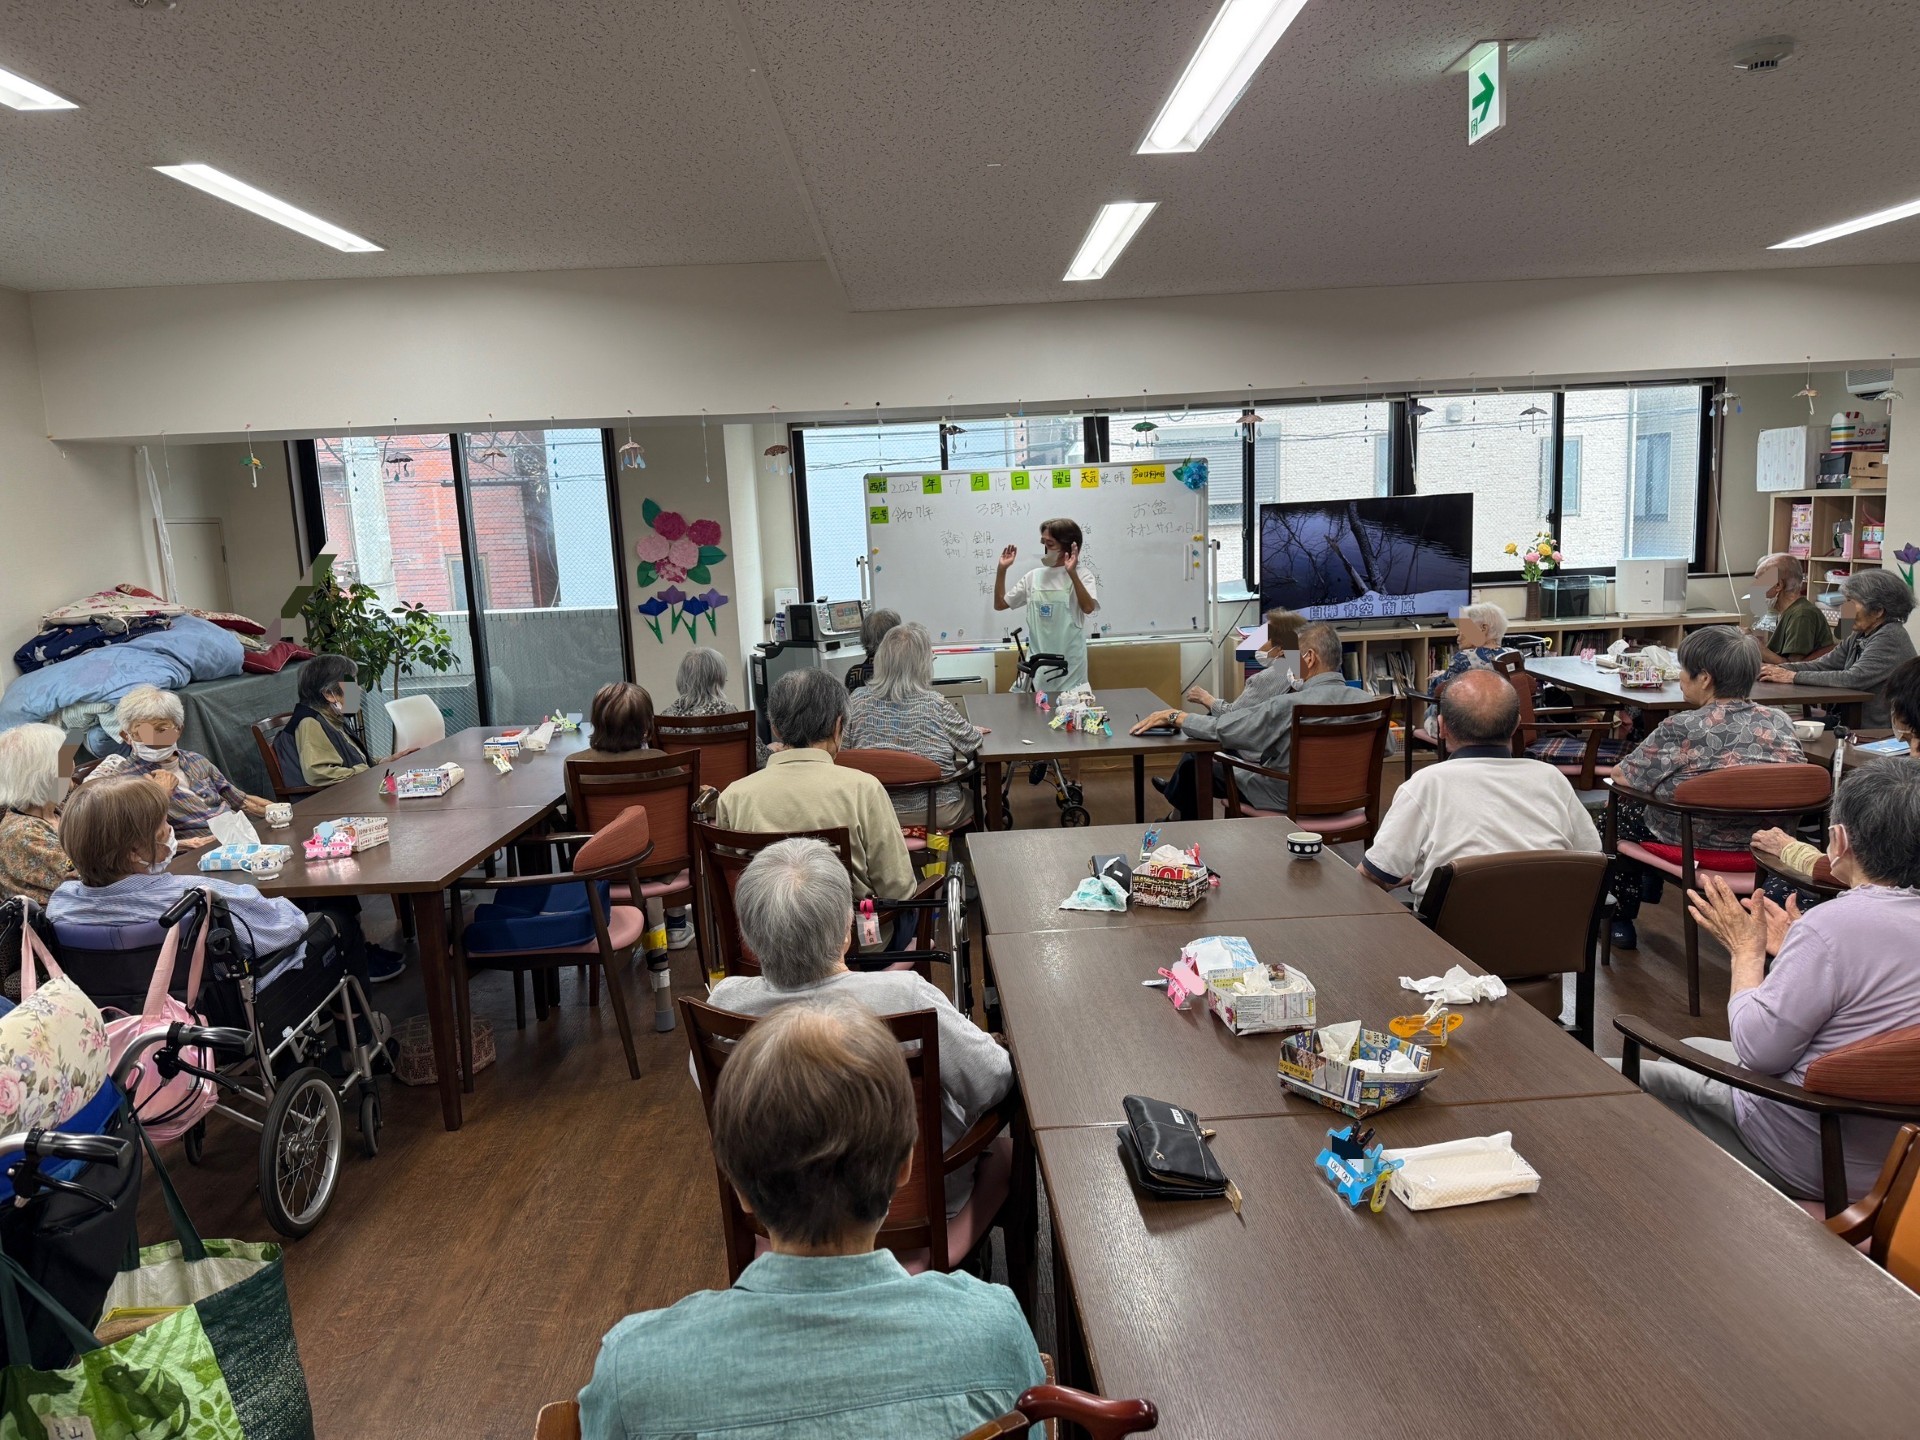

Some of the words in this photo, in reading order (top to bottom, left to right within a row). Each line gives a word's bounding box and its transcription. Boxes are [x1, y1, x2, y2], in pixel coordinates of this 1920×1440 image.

[1858, 429, 1876, 437] 500
[891, 480, 918, 494] 2025
[926, 479, 938, 492] 年
[949, 479, 960, 494] 7
[974, 475, 984, 487] 月
[995, 477, 1007, 492] 15
[1014, 475, 1024, 486] 日
[1034, 474, 1048, 489] 火
[1053, 471, 1071, 484] 曜日
[1081, 470, 1097, 483] 天気
[1132, 468, 1165, 479] 今日は何の日
[870, 509, 888, 520] 元号
[1310, 605, 1338, 619] 白樺
[1343, 602, 1374, 617] 青空
[1382, 600, 1416, 615] 南風
